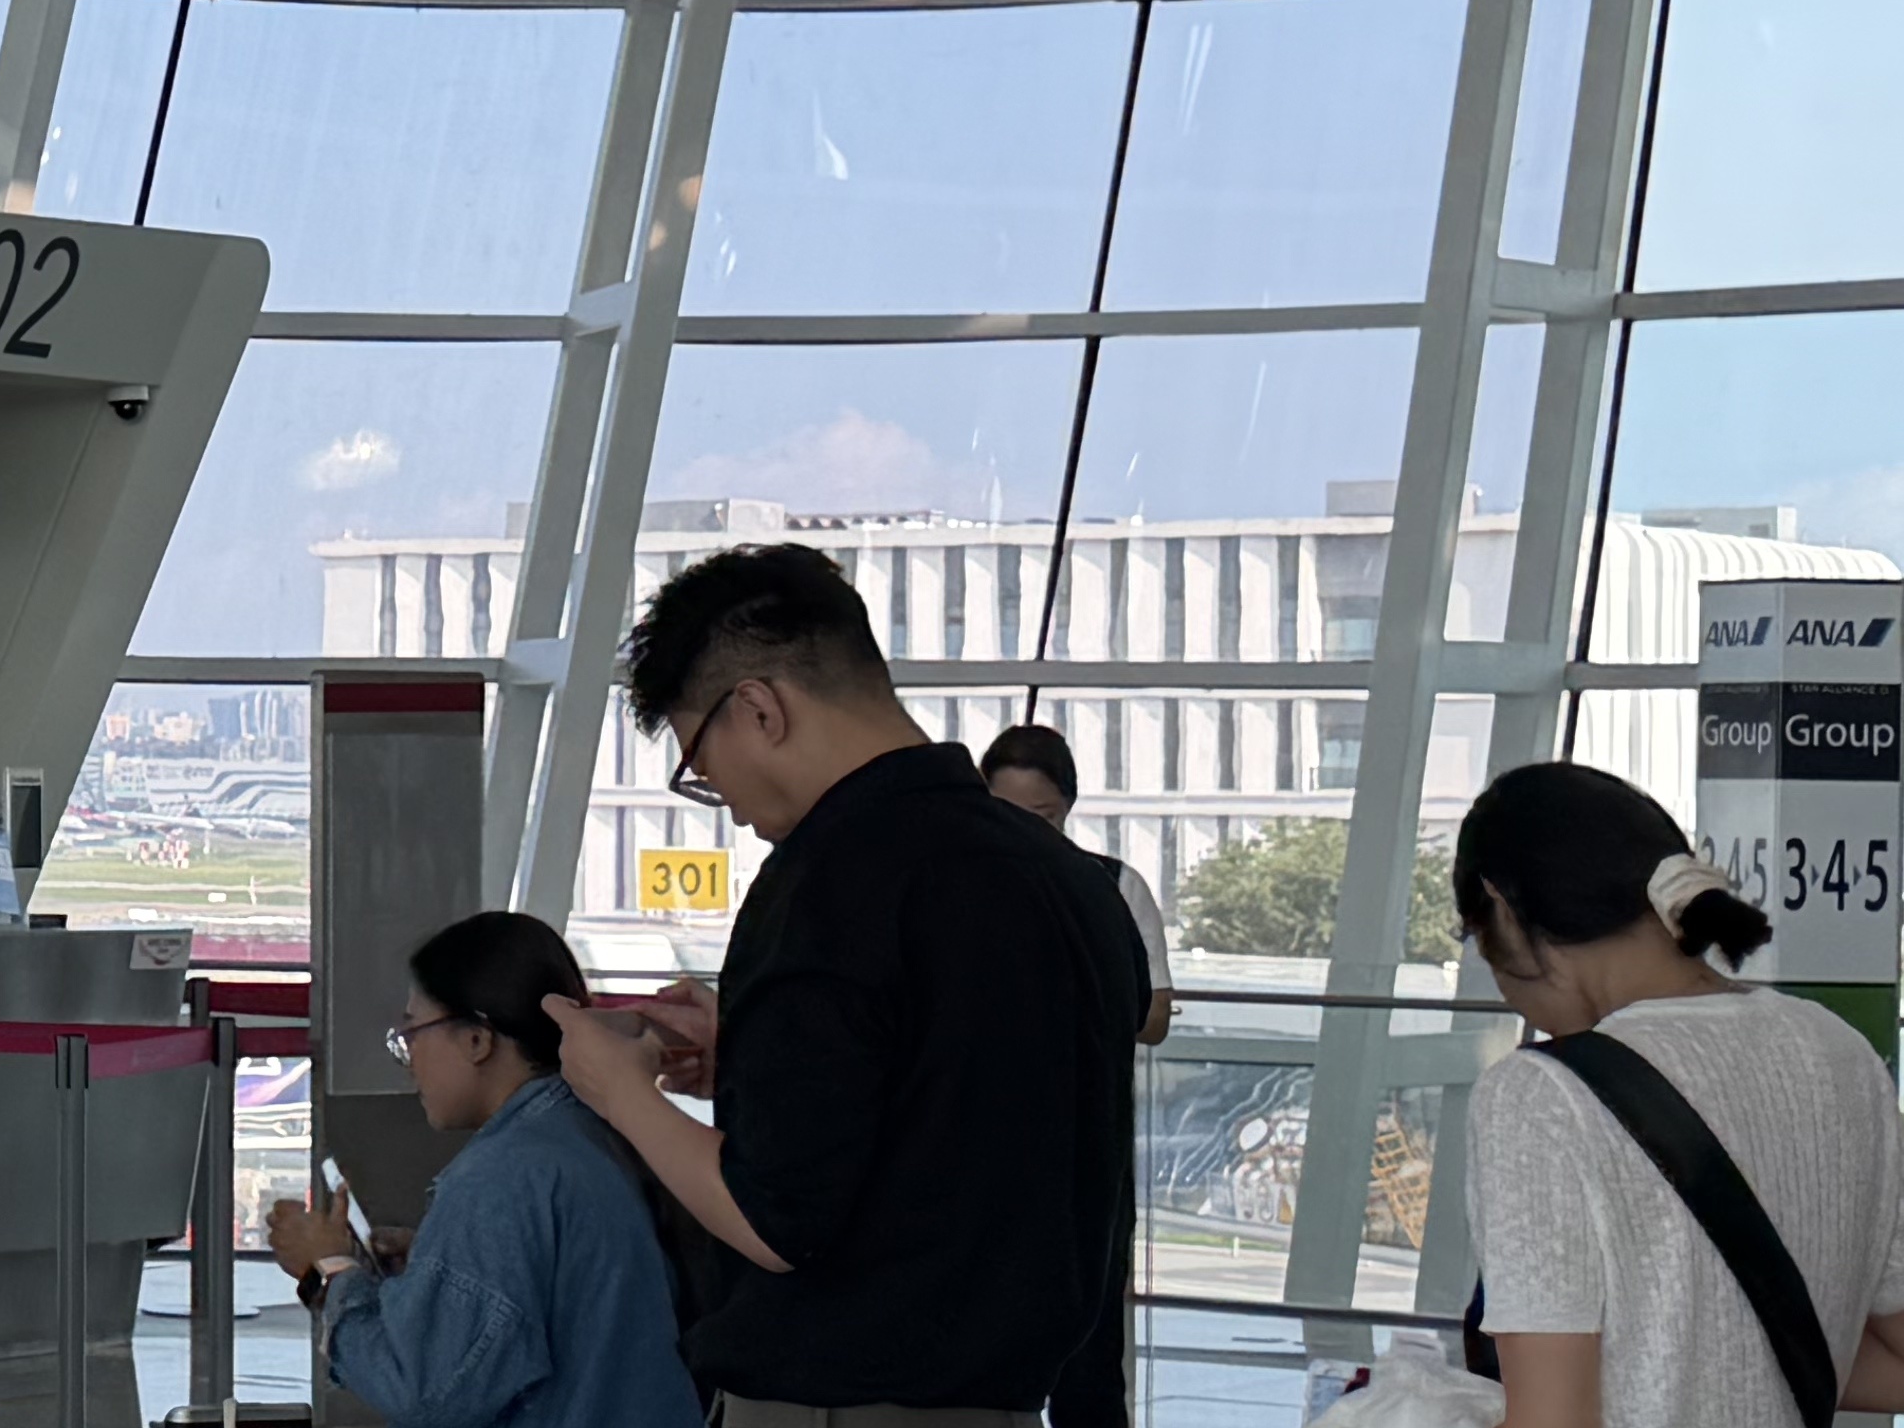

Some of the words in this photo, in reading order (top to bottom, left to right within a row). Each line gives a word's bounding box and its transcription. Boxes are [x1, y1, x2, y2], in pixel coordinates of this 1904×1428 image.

[1705, 619, 1750, 647] ANA
[1786, 619, 1856, 647] ANA
[1702, 714, 1772, 754] Group
[1785, 714, 1895, 756] Group
[651, 861, 718, 897] 301
[1784, 837, 1807, 911] 3
[1822, 839, 1849, 911] 4
[1864, 839, 1889, 912] 5
